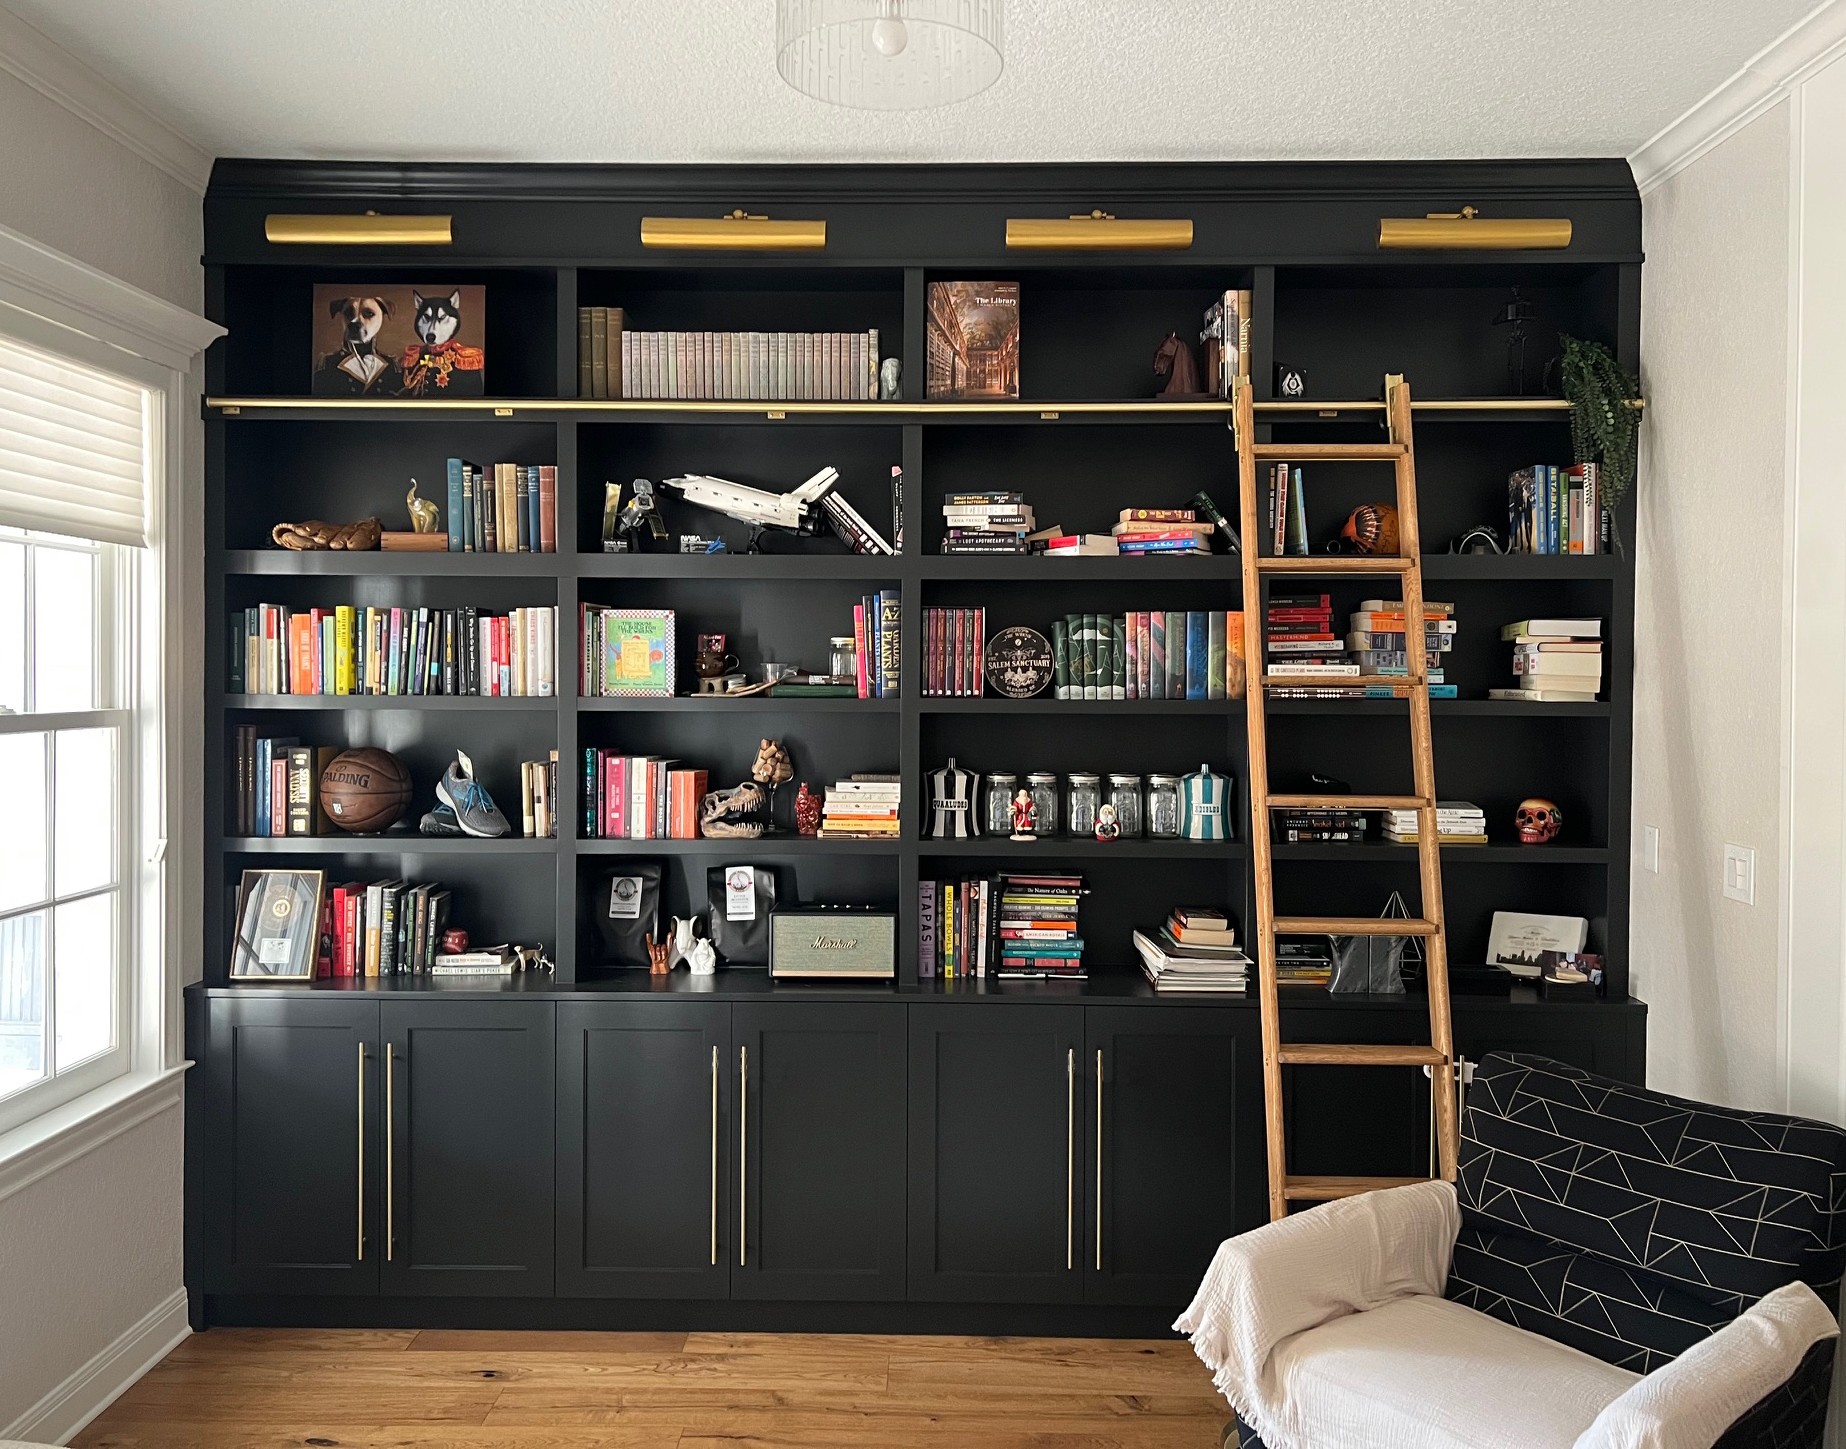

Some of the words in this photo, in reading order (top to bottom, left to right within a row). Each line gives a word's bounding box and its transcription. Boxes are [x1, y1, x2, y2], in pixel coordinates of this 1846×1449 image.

[991, 297, 1017, 306] Library
[1240, 318, 1250, 353] Narnia
[301, 652, 310, 670] FINANCE
[882, 630, 893, 669] PLANTS
[988, 660, 1010, 670] SALEM
[1012, 660, 1050, 668] SANCTUARY
[290, 768, 300, 804] ANALYSIS
[300, 768, 310, 804] SECURITY
[922, 894, 932, 942] TAPAS
[810, 936, 858, 950] Marshall
